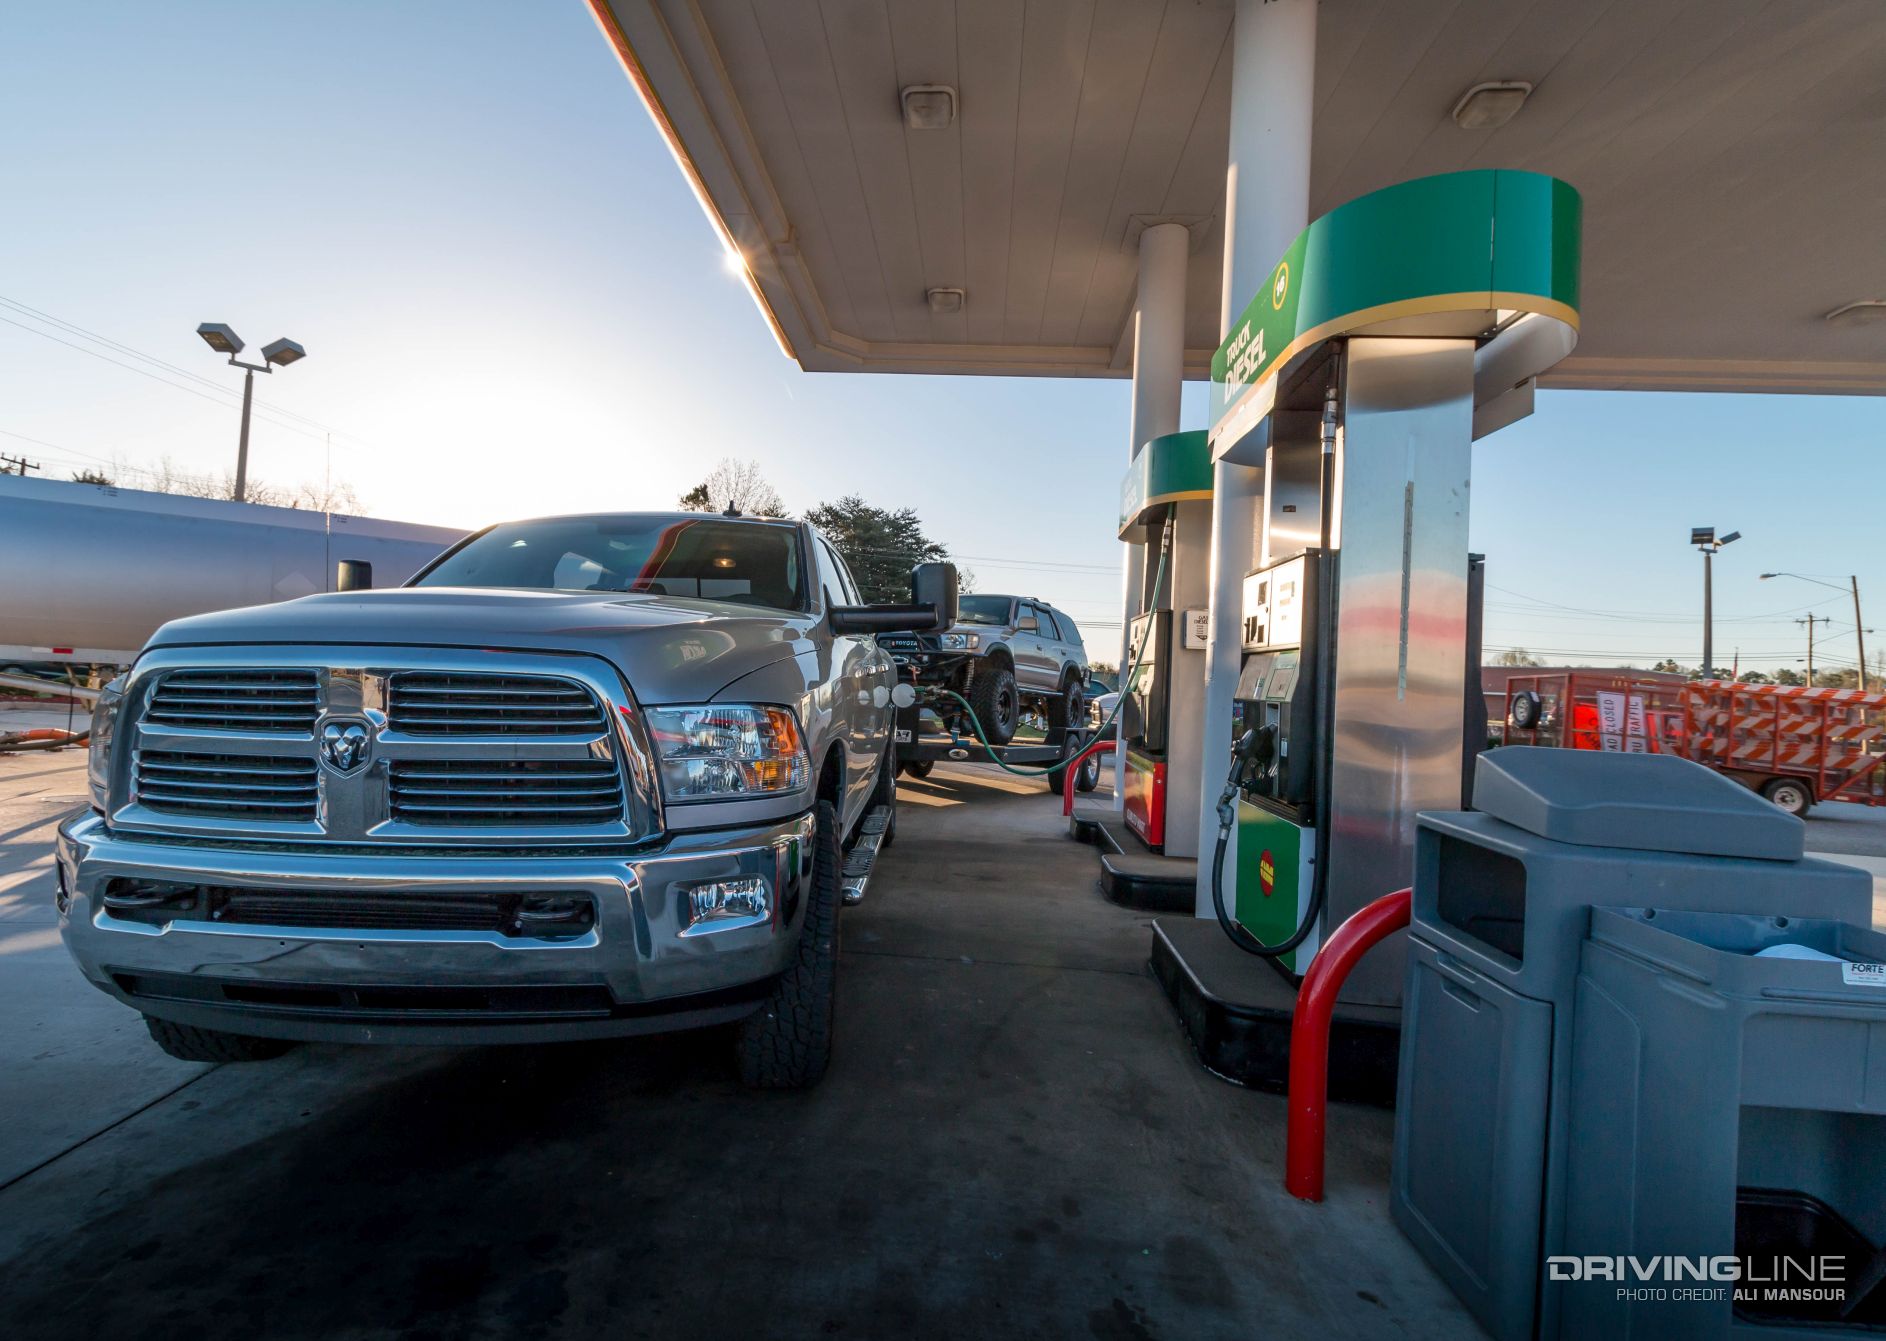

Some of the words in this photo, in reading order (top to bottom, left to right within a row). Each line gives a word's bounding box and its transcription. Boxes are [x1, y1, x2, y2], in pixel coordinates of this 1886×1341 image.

[1226, 319, 1251, 368] TRUCK
[1224, 328, 1267, 405] DIESEL
[1604, 699, 1617, 734] CLOSED
[1851, 963, 1884, 973] FORTE
